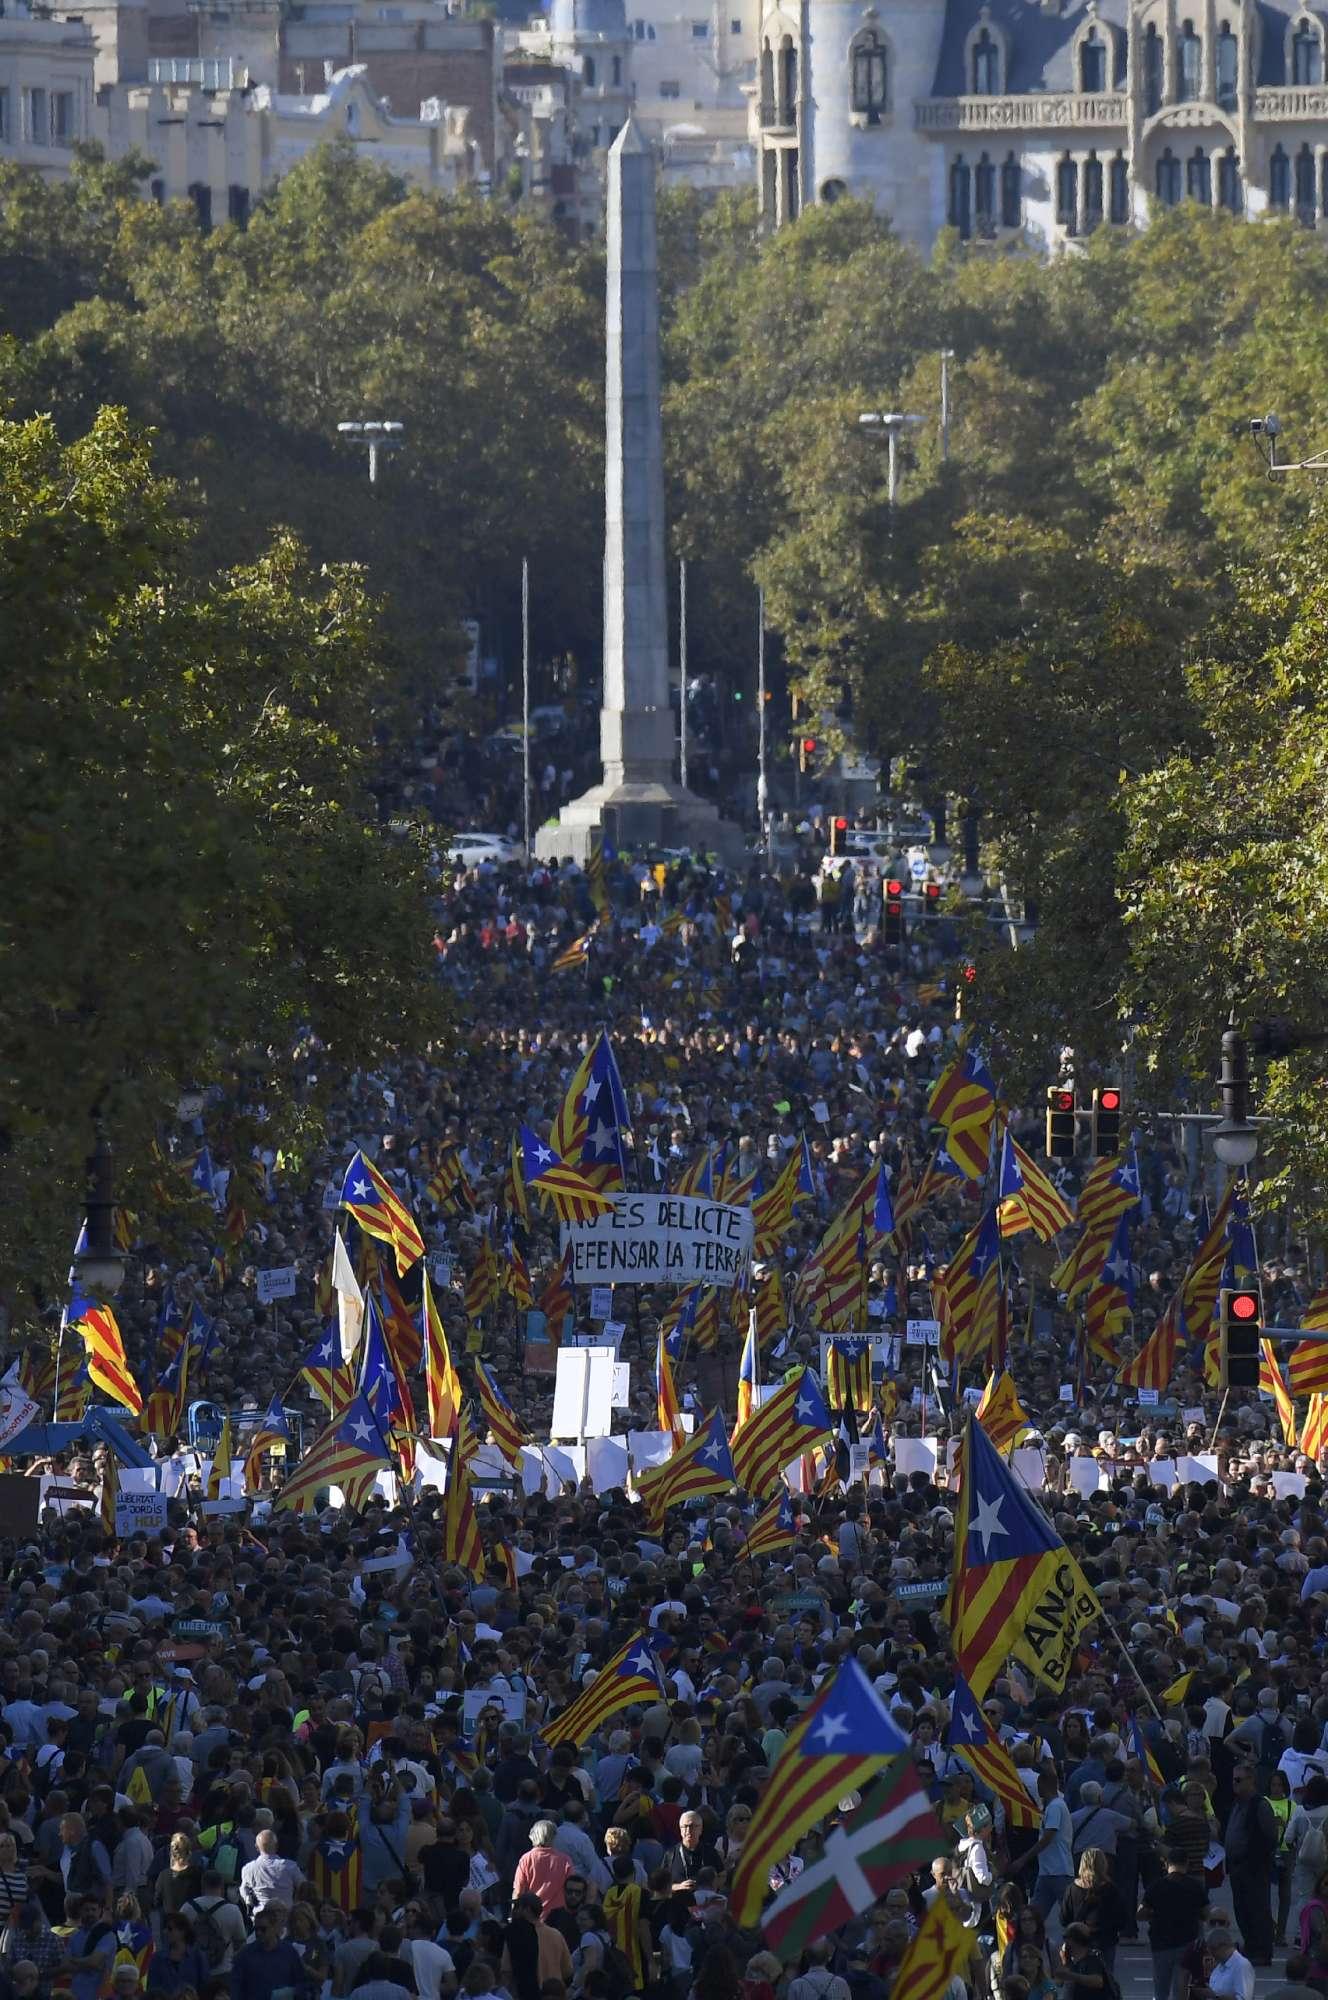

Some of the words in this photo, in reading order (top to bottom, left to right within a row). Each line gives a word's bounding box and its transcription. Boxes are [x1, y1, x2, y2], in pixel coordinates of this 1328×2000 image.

[658, 1199, 742, 1241] DELICTE
[574, 1240, 660, 1271] EFENSAR
[667, 1240, 684, 1269] LA
[693, 1240, 741, 1274] TERRA
[899, 1582, 944, 1596] LLIBERTAT
[179, 1621, 222, 1633] LLIBERTAT
[1024, 1564, 1075, 1659] ANC
